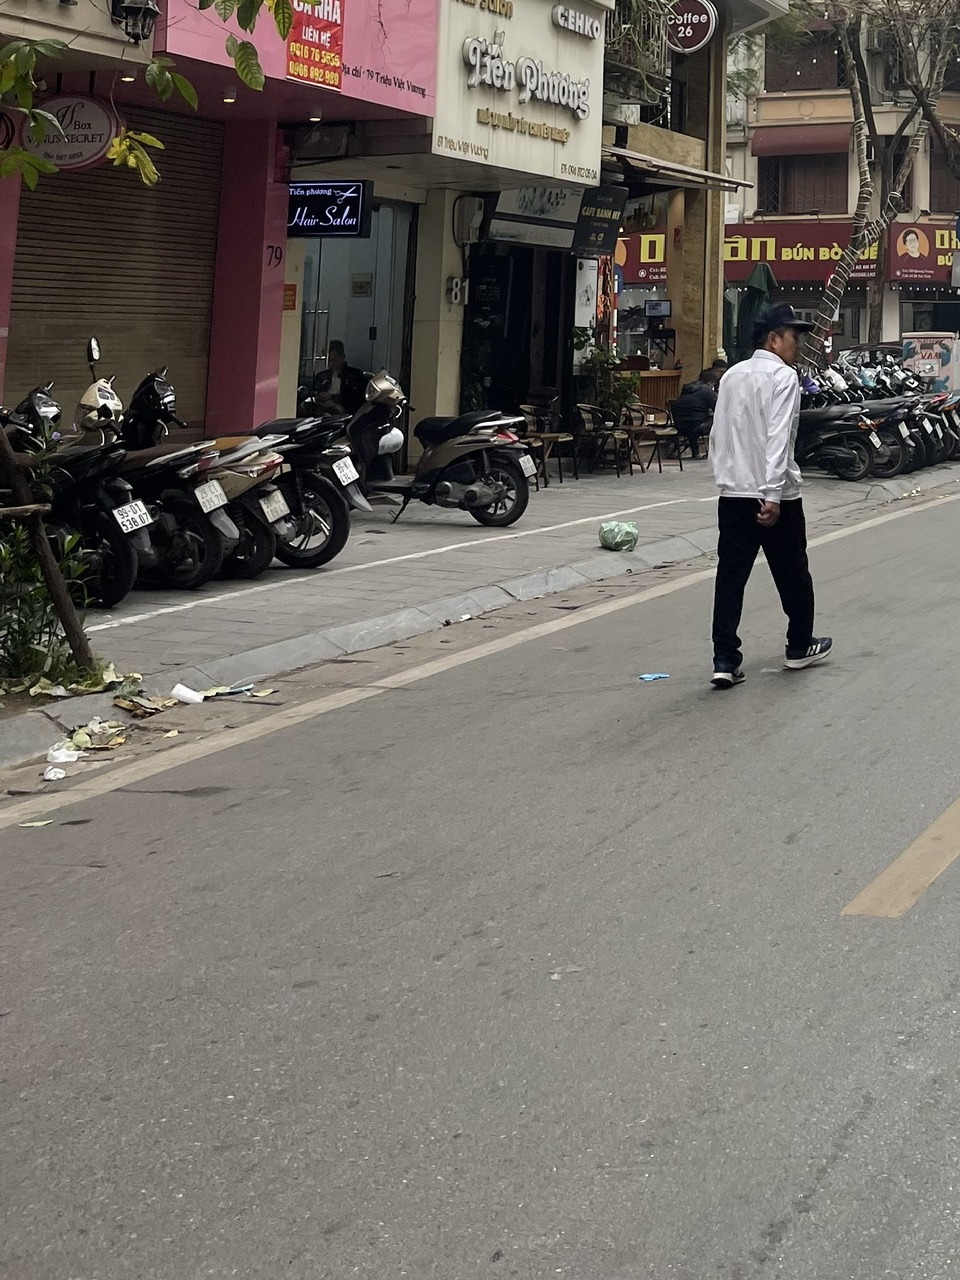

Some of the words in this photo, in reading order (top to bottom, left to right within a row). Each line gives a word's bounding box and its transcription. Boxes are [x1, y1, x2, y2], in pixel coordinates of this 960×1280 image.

[302, 25, 319, 42] LIÊN
[321, 30, 332, 49] HỆ
[678, 26, 693, 37] 26
[463, 29, 515, 91] Tiến
[515, 55, 591, 120] Phương
[73, 121, 92, 130] Box
[65, 133, 104, 143] SECRET
[287, 206, 319, 226] Hair
[319, 205, 357, 226] Salon
[266, 244, 283, 268] 79
[781, 242, 814, 260] BÚN
[819, 242, 843, 260] BÒ
[451, 278, 469, 305] 81
